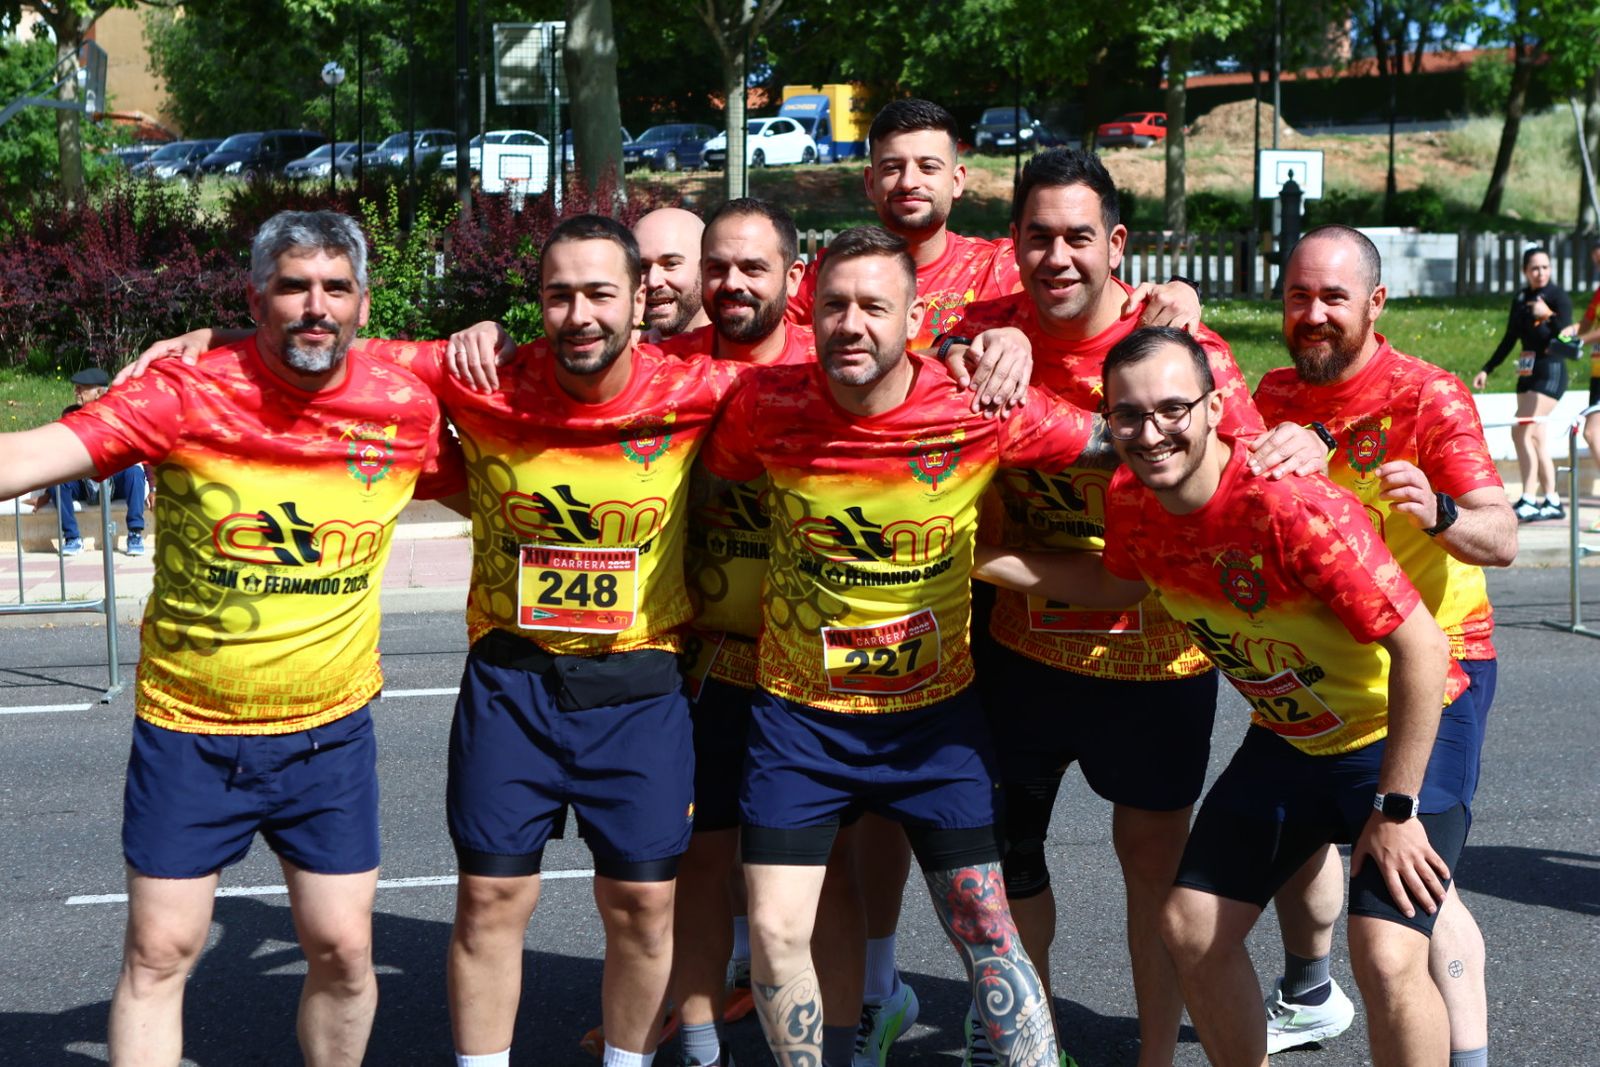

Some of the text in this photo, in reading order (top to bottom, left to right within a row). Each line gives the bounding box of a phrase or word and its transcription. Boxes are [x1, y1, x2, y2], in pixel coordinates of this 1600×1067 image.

[553, 558, 606, 570] CARRERA
[208, 565, 238, 588] SAN
[265, 574, 341, 596] FERNANDO
[845, 568, 921, 587] FERNANDO
[537, 571, 618, 608] 248
[856, 629, 907, 647] CARRERA
[845, 638, 922, 677] 227
[1114, 662, 1139, 676] VALOR
